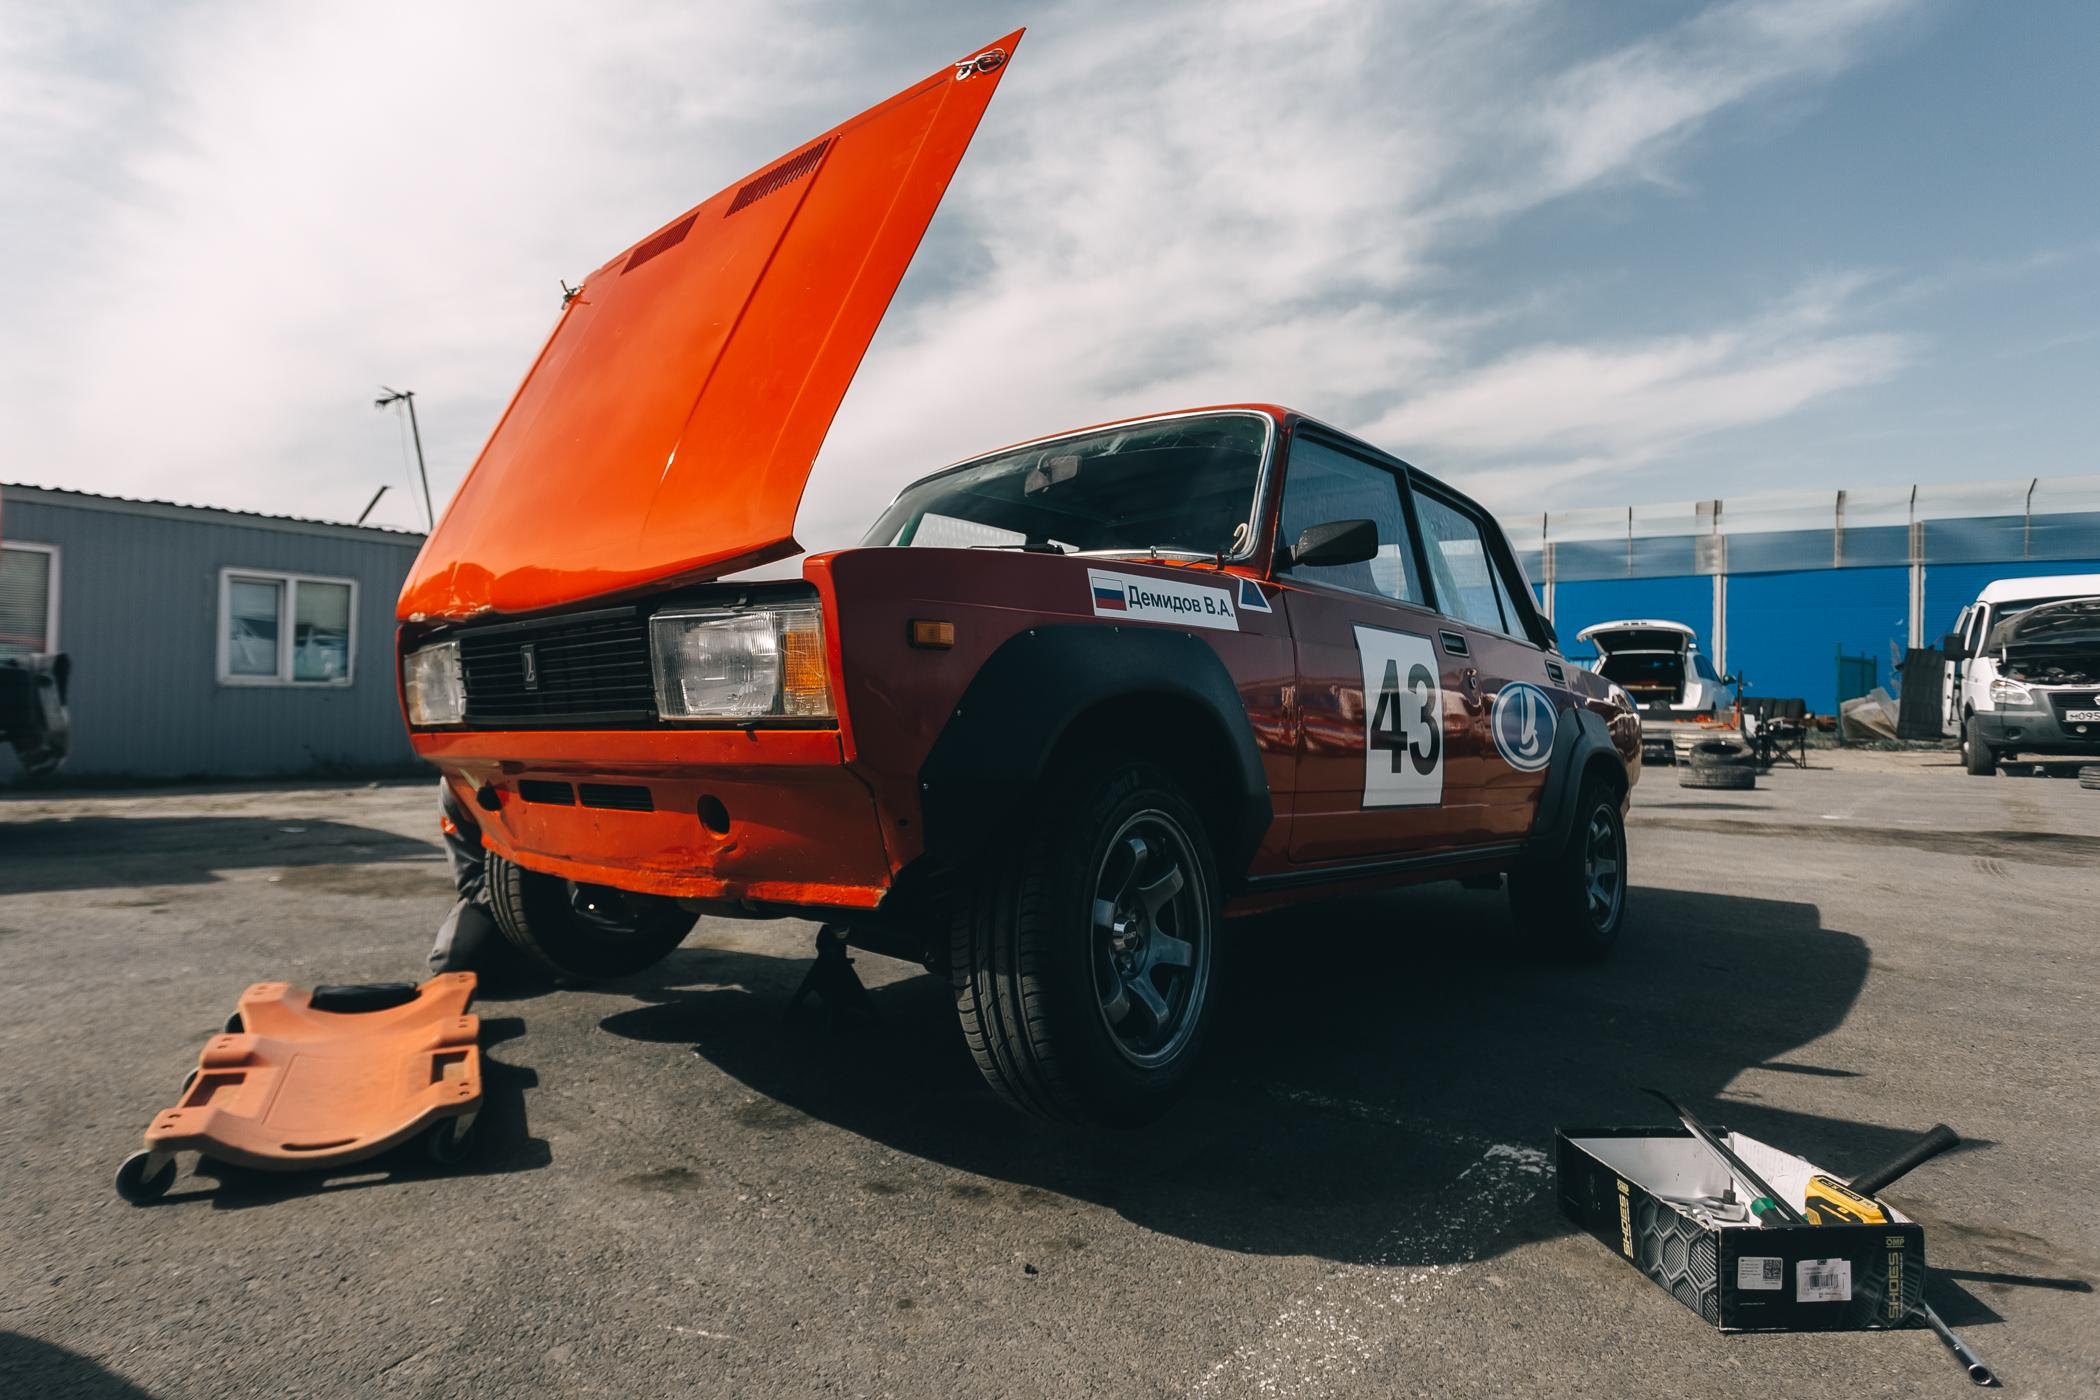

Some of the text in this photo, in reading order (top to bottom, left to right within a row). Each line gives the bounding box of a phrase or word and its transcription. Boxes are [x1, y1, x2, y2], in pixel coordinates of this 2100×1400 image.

[1128, 585, 1234, 617] Демидов В.А.
[1370, 659, 1440, 776] 43
[1619, 1193, 1631, 1257] SHOES
[1886, 1237, 1904, 1247] OMP
[1888, 1252, 1899, 1318] SHOES
